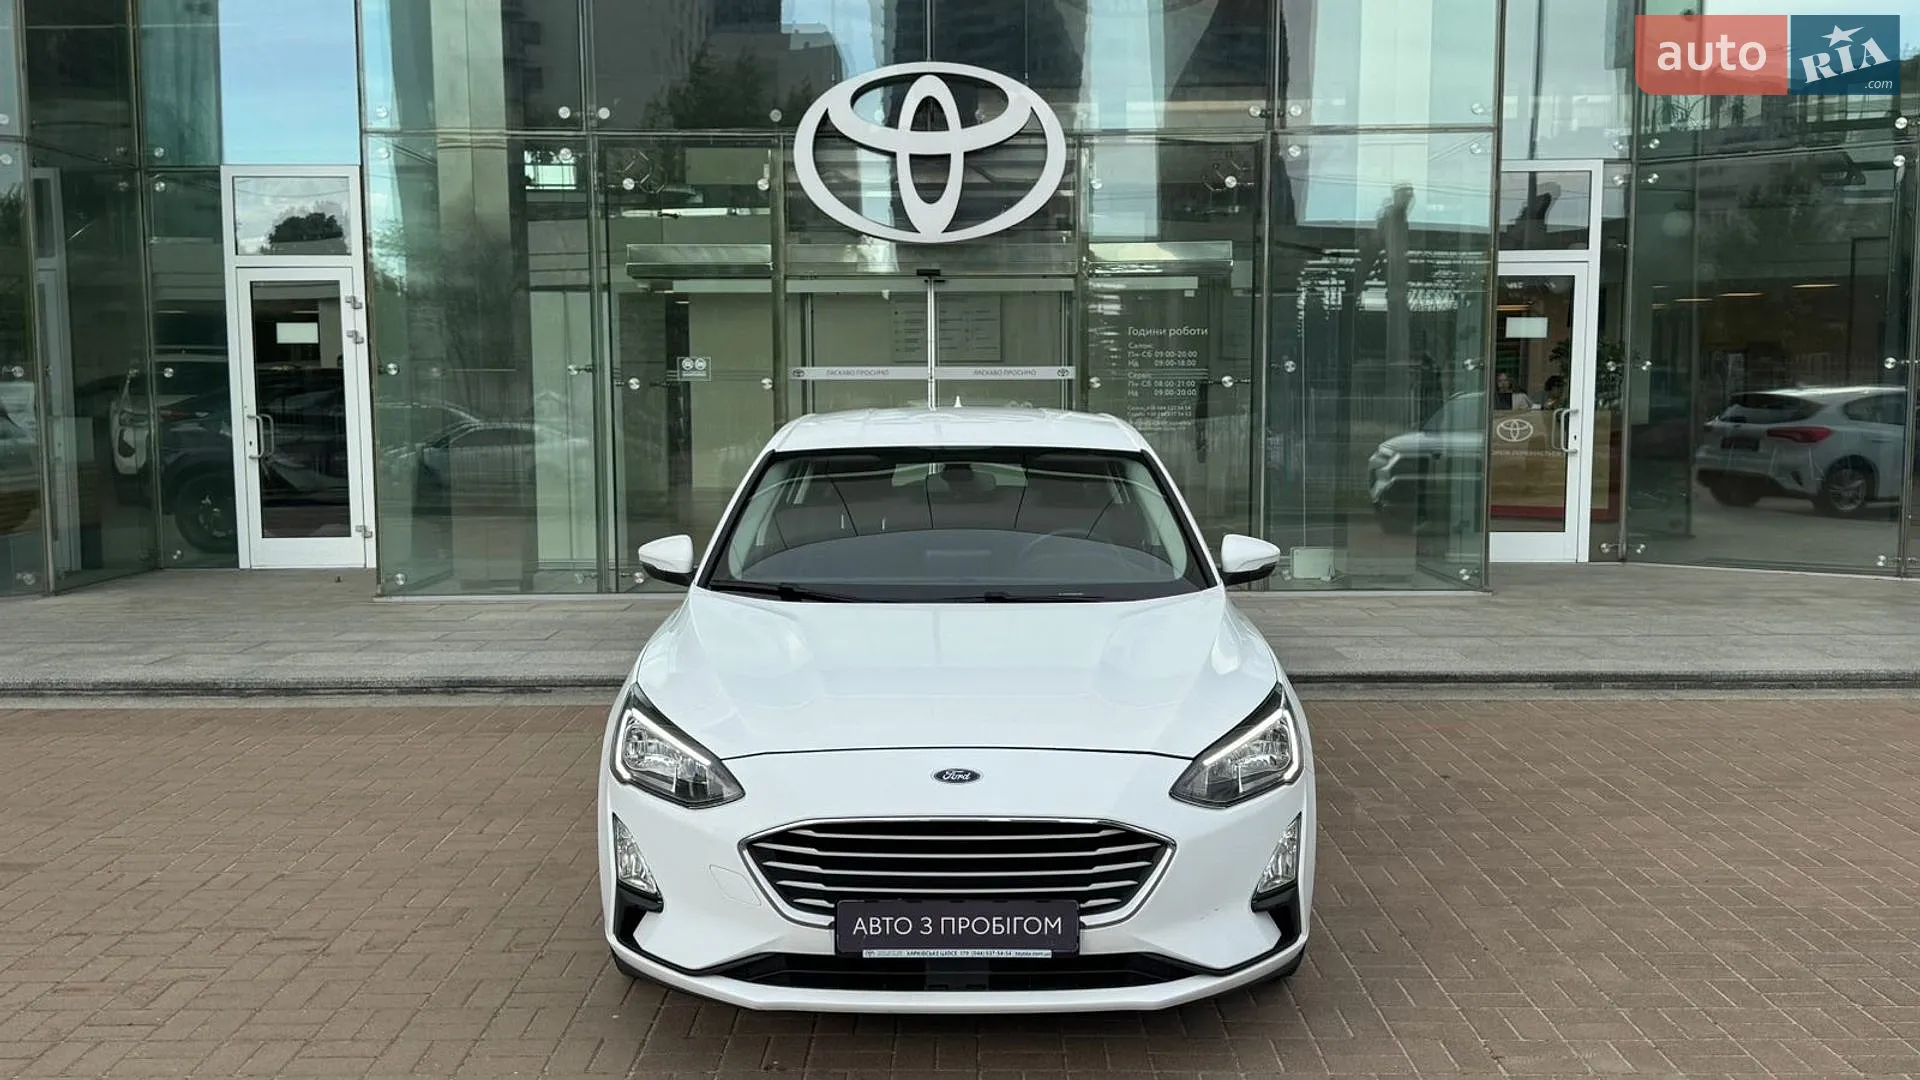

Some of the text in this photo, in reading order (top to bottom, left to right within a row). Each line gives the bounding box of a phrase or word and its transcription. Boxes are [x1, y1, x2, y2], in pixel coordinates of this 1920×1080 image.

[1127, 326, 1209, 337] Години роботи
[943, 770, 971, 780] Ford
[852, 916, 913, 936] АВТО
[940, 916, 1062, 936] ПРОБІГОМ
